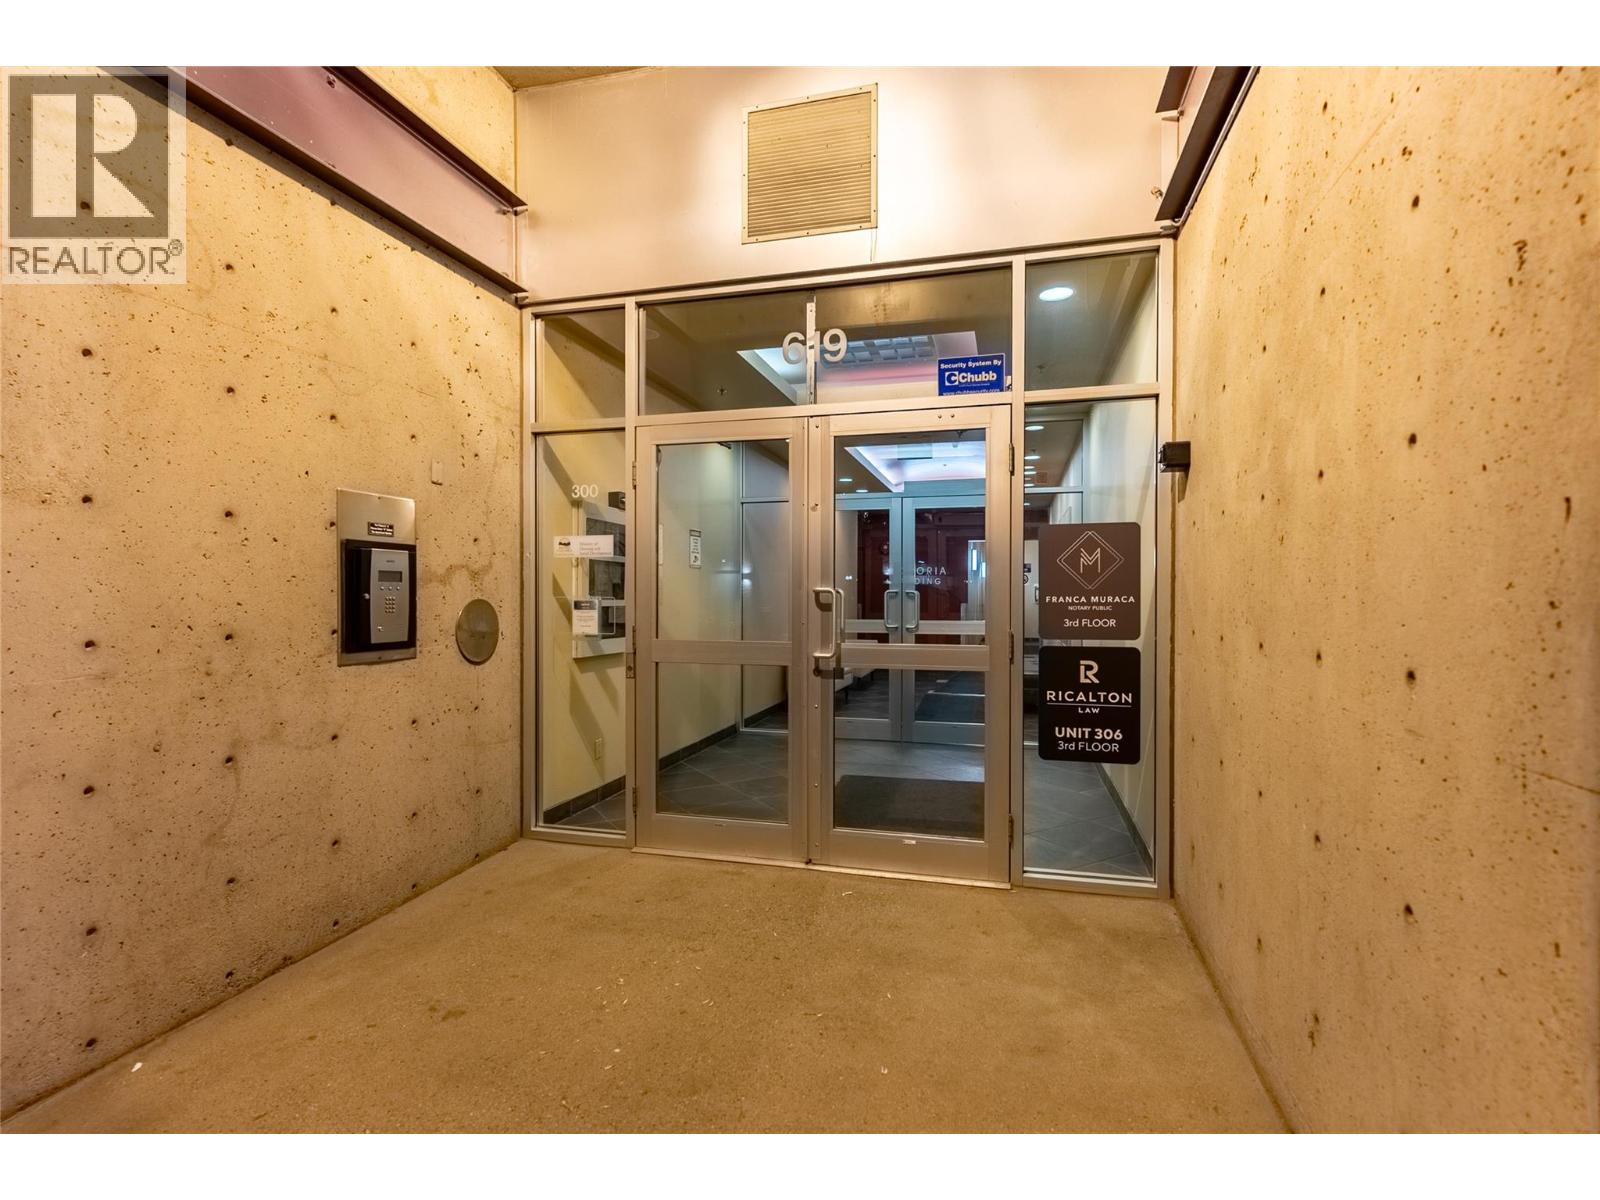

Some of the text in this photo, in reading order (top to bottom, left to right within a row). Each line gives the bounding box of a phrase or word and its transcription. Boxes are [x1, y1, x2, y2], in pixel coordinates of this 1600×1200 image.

[782, 328, 848, 365] 619
[959, 370, 997, 383] Chubb
[571, 484, 599, 498] 300
[1045, 595, 1136, 603] FRANCA MURACA
[1063, 618, 1117, 627] 3rd FLOOR
[1046, 690, 1132, 704] RICALTON
[1055, 726, 1123, 740] UNIT 306
[1057, 741, 1120, 753] 3rd FLOOR
